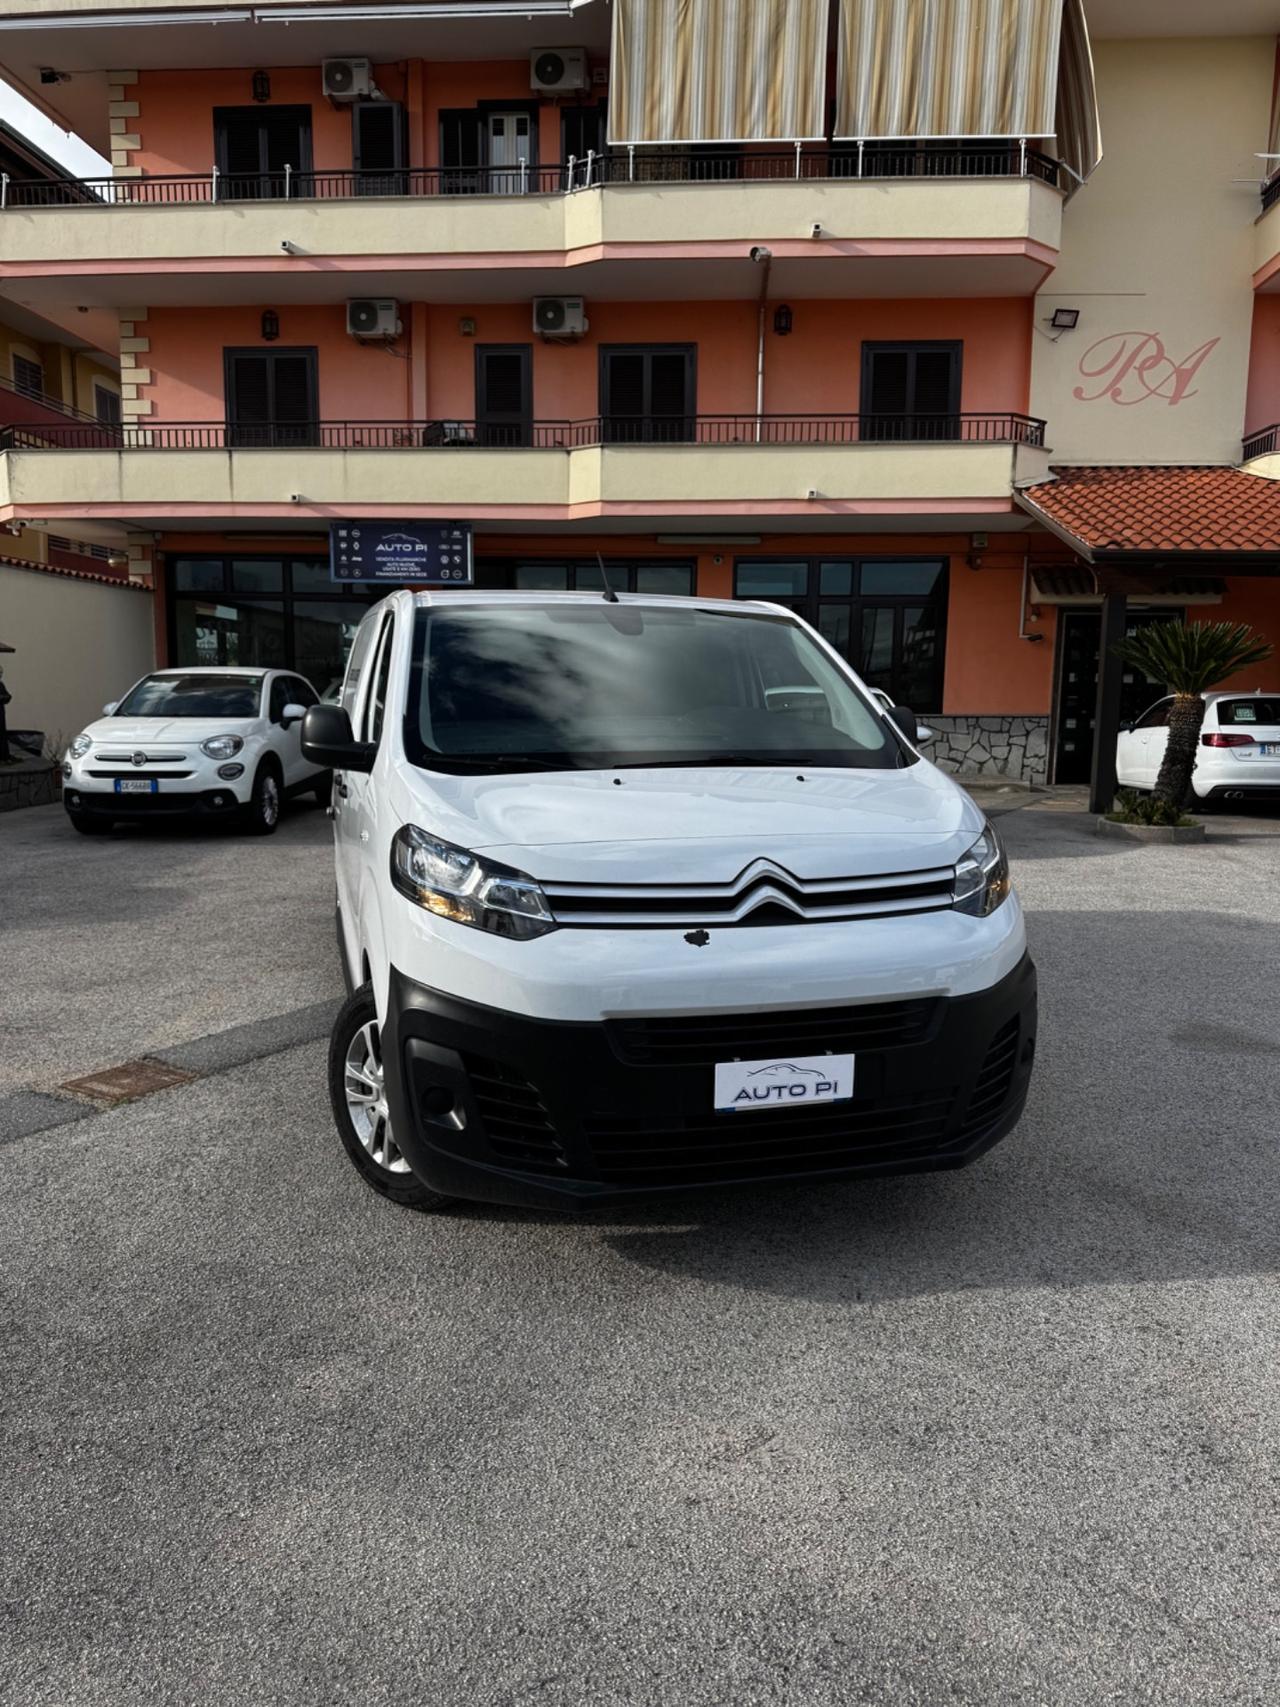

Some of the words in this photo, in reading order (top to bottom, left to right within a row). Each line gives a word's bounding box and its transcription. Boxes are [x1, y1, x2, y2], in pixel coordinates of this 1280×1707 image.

[376, 543, 412, 552] AUTO
[415, 543, 428, 552] PI
[733, 1084, 807, 1102] AUTO
[815, 1081, 838, 1096] PI
